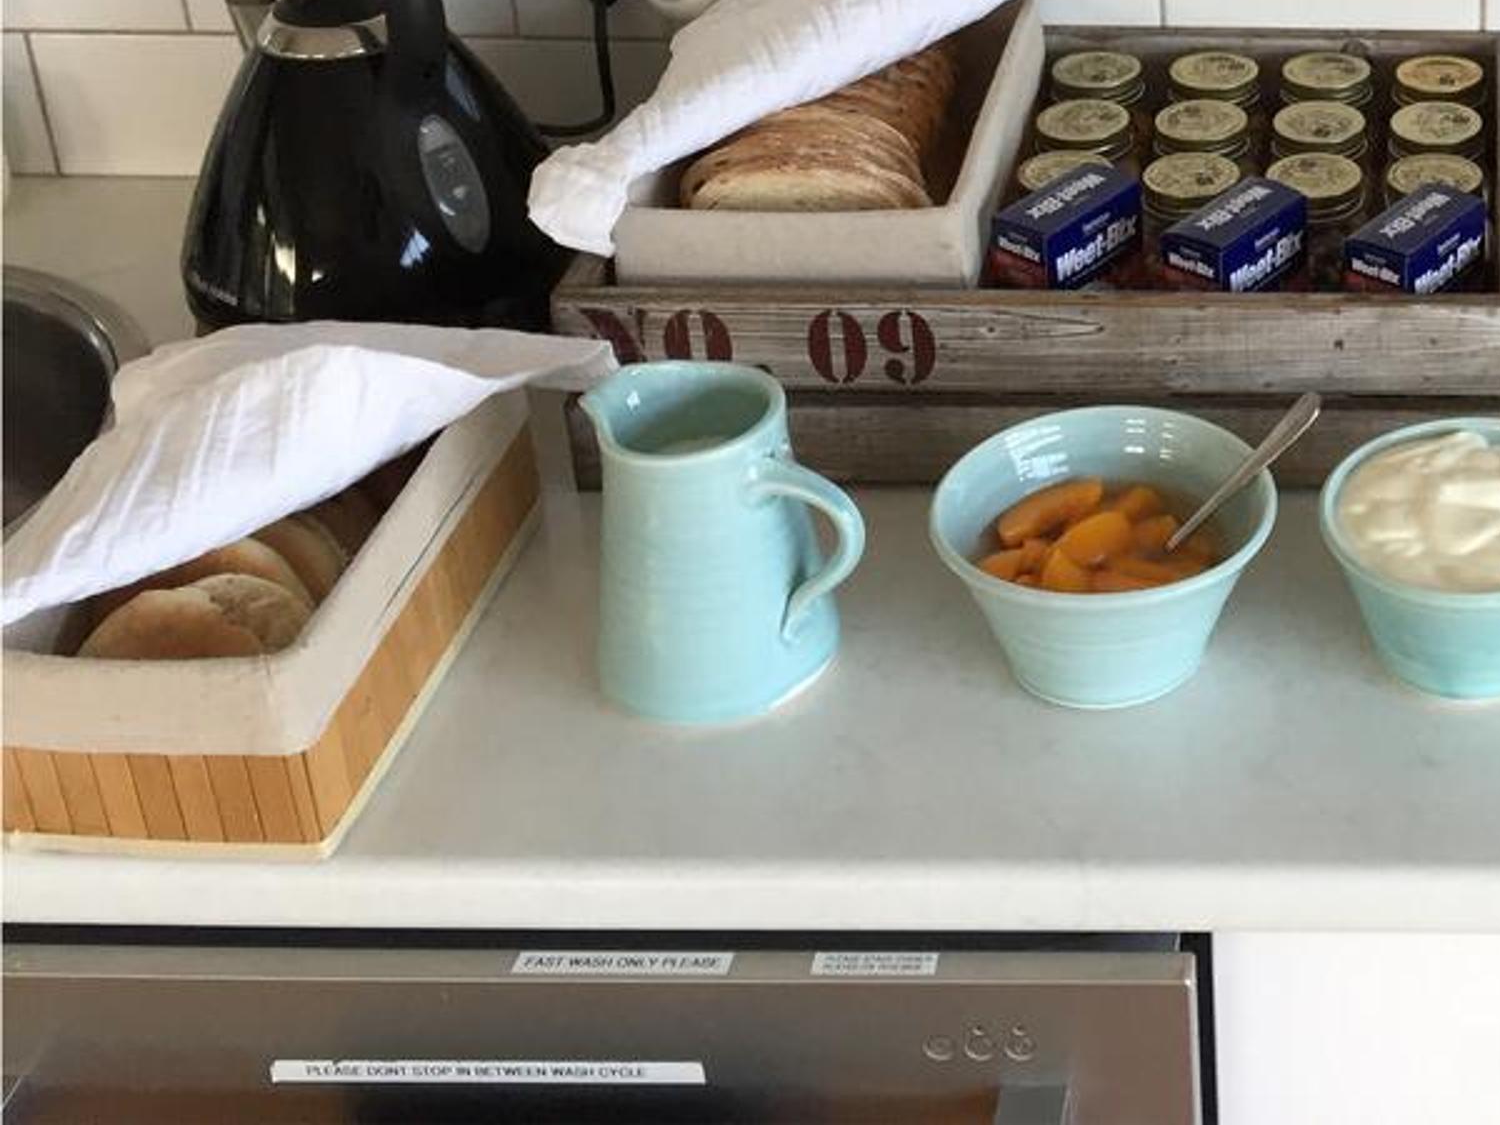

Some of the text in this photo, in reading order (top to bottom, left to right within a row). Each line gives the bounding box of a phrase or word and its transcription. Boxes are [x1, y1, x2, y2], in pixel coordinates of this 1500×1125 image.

[808, 308, 937, 385] 09
[524, 956, 721, 967] FAST WASH ONLY PLEASE
[305, 1064, 360, 1076] PLEASE
[412, 1064, 451, 1076] STOP
[455, 1064, 471, 1076] IN
[474, 1065, 546, 1076] BETWEEN
[549, 1065, 595, 1077] WASH
[598, 1065, 642, 1077] CYCLE
